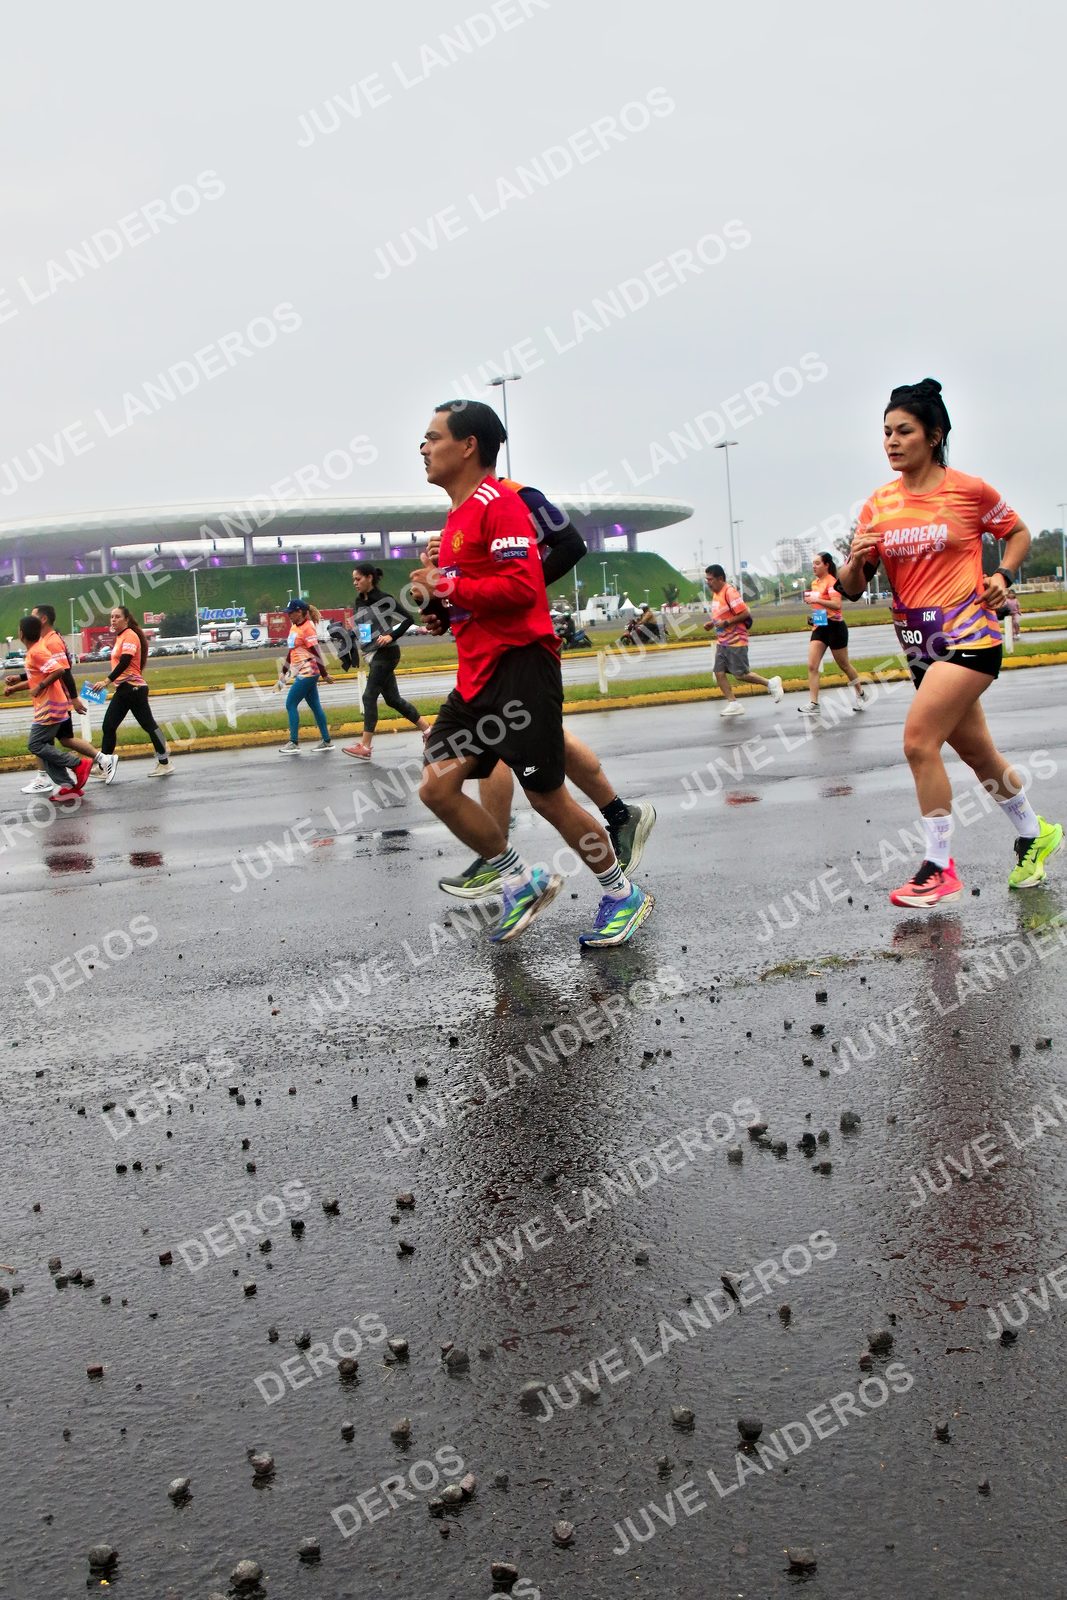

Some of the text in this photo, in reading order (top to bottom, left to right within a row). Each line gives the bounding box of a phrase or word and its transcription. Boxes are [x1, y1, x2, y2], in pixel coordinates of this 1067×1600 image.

[883, 523, 948, 546] CARRERA
[884, 542, 931, 558] OMNILIFE
[922, 610, 937, 622] 15K
